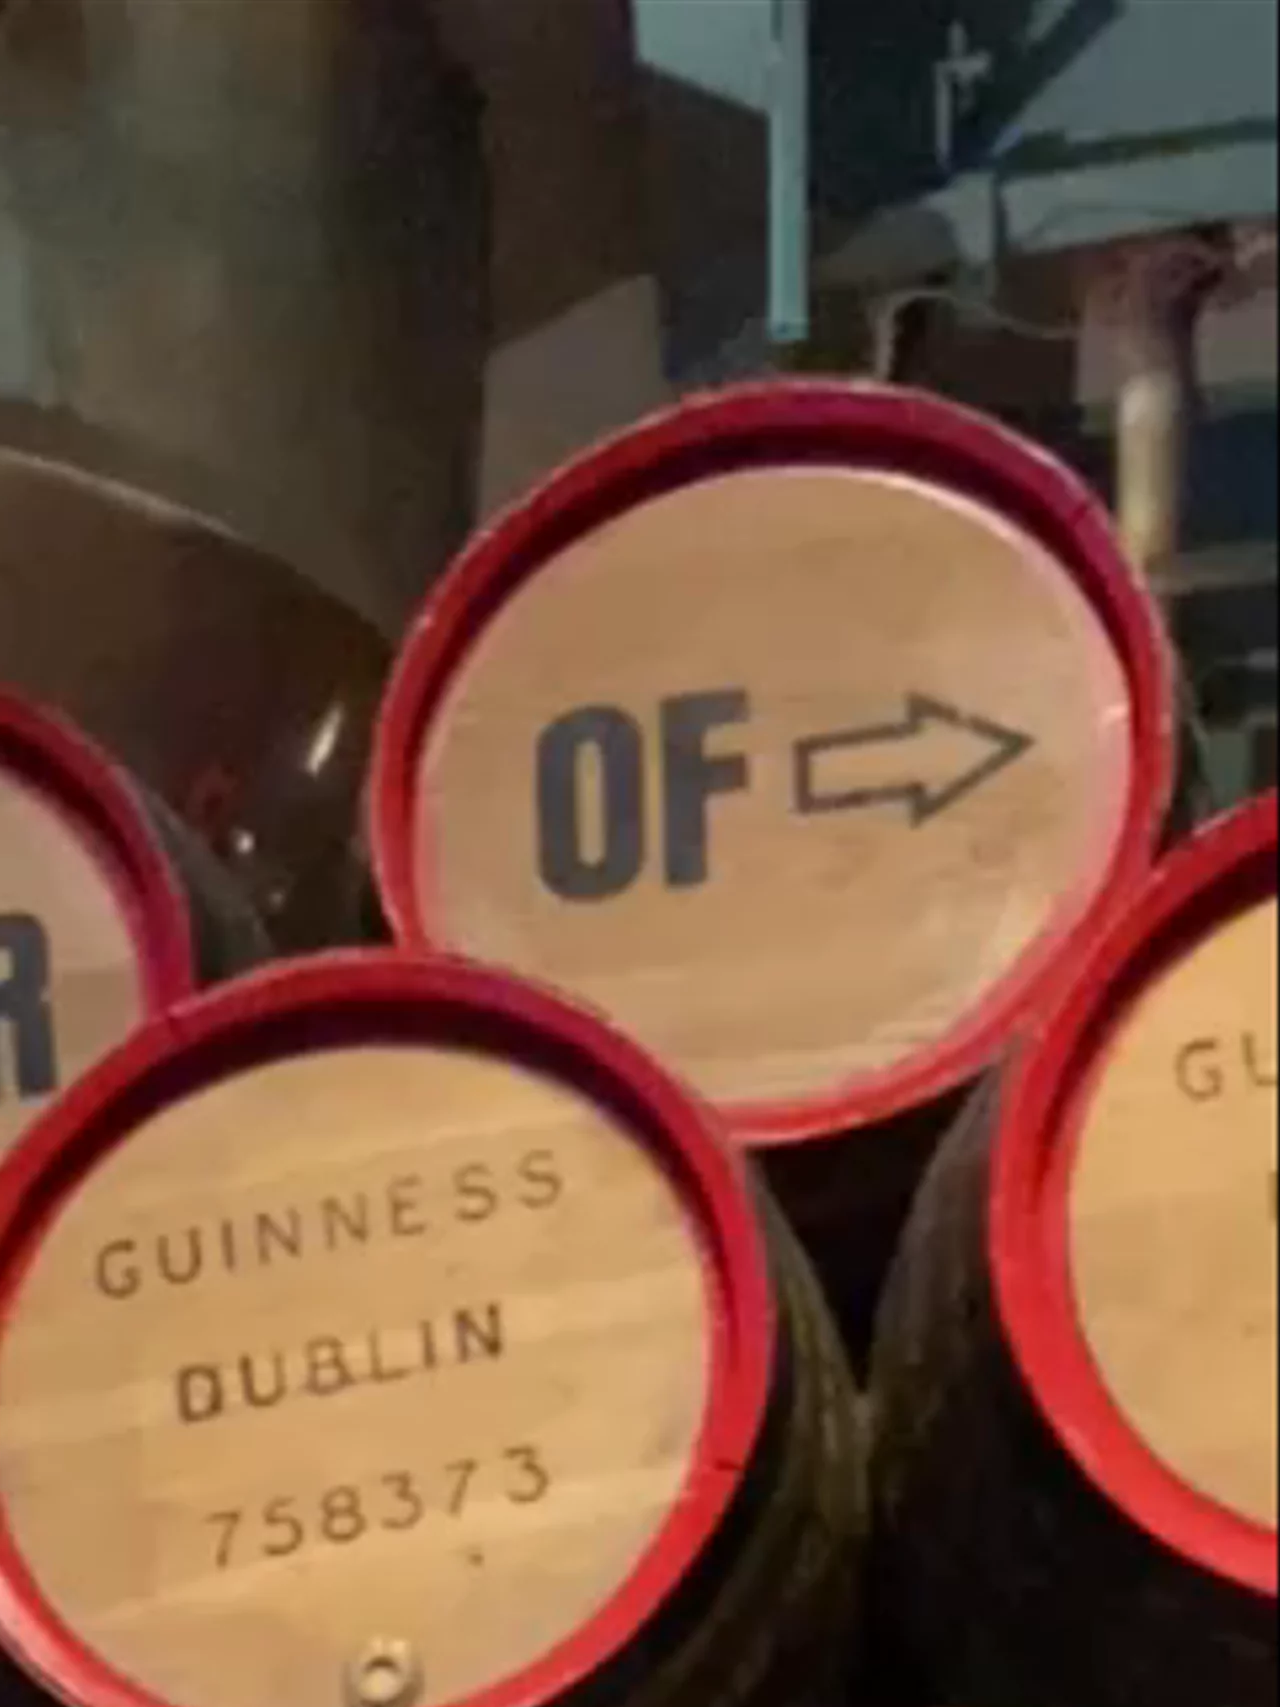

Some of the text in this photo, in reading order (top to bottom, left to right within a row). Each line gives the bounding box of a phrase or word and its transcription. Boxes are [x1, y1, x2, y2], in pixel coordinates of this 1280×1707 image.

[535, 688, 751, 903] OF
[94, 1148, 564, 1301] GUINNESS
[173, 1301, 505, 1425] DUBLIN
[205, 1443, 552, 1569] 758373
